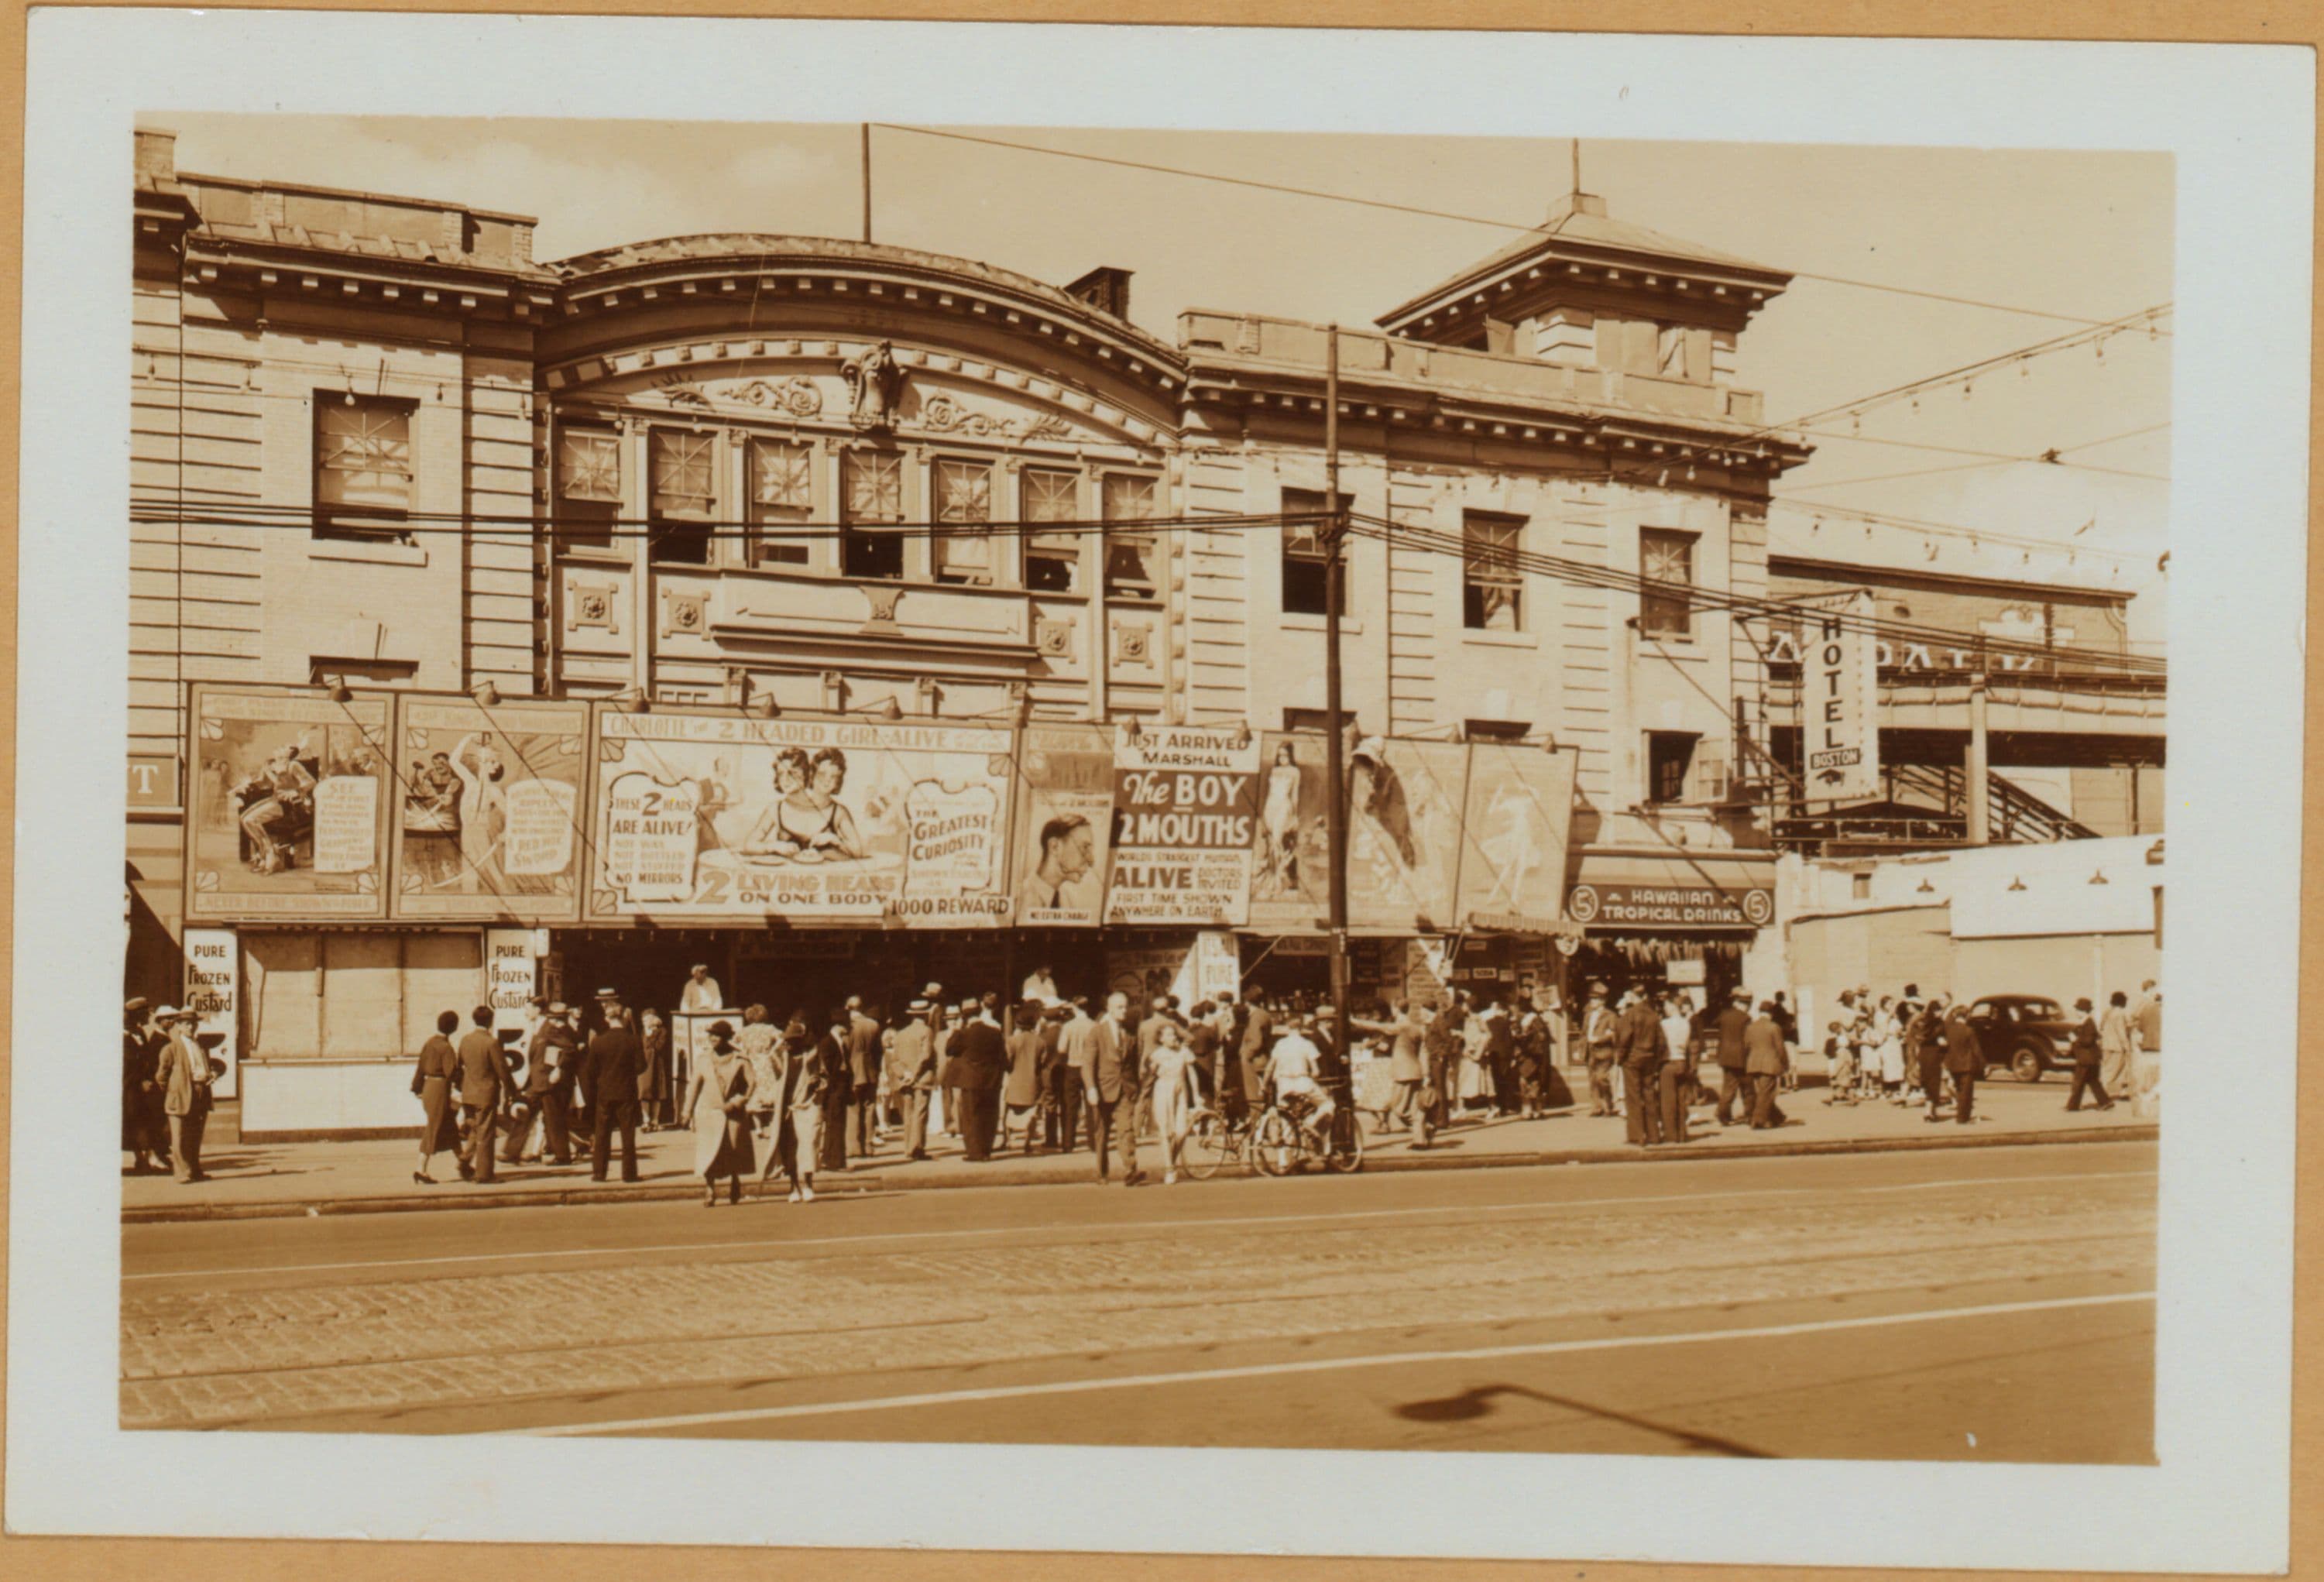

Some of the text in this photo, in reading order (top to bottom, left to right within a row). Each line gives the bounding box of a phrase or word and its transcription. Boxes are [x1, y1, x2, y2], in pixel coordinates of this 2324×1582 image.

[1821, 617, 1845, 750] HOTEL
[719, 721, 734, 739] 2
[743, 721, 825, 744] HEADED
[1166, 733, 1251, 751] ARRIVED
[1142, 751, 1232, 767] MARSHALL
[1813, 750, 1857, 767] BOSTON
[1123, 771, 1248, 808] The BOY
[616, 798, 640, 810] THESE
[642, 791, 662, 816] 2
[613, 820, 692, 836] ARE ALIVE!
[914, 814, 987, 841] GREATEST
[1118, 813, 1251, 846] 2 MOUTHS
[912, 834, 984, 861] CURIOSITY
[616, 873, 683, 884] NO MIRRORS
[1112, 866, 1193, 889] ALIVE
[696, 871, 729, 904] 2
[736, 873, 818, 892] LIVING
[740, 892, 887, 905] ON ONE BODY
[890, 898, 1008, 915] 1000 REWARD
[1116, 892, 1233, 904] FIRST TIME SHOWN
[1110, 905, 1223, 918] ANYWHERE ON EARTH
[1601, 904, 1742, 923] TROPICAL DRINKS
[194, 945, 227, 958] PURE
[496, 945, 526, 958] PURE
[187, 965, 231, 986] FROZEN
[491, 963, 533, 983] FROZEN
[187, 991, 232, 1012] Custard
